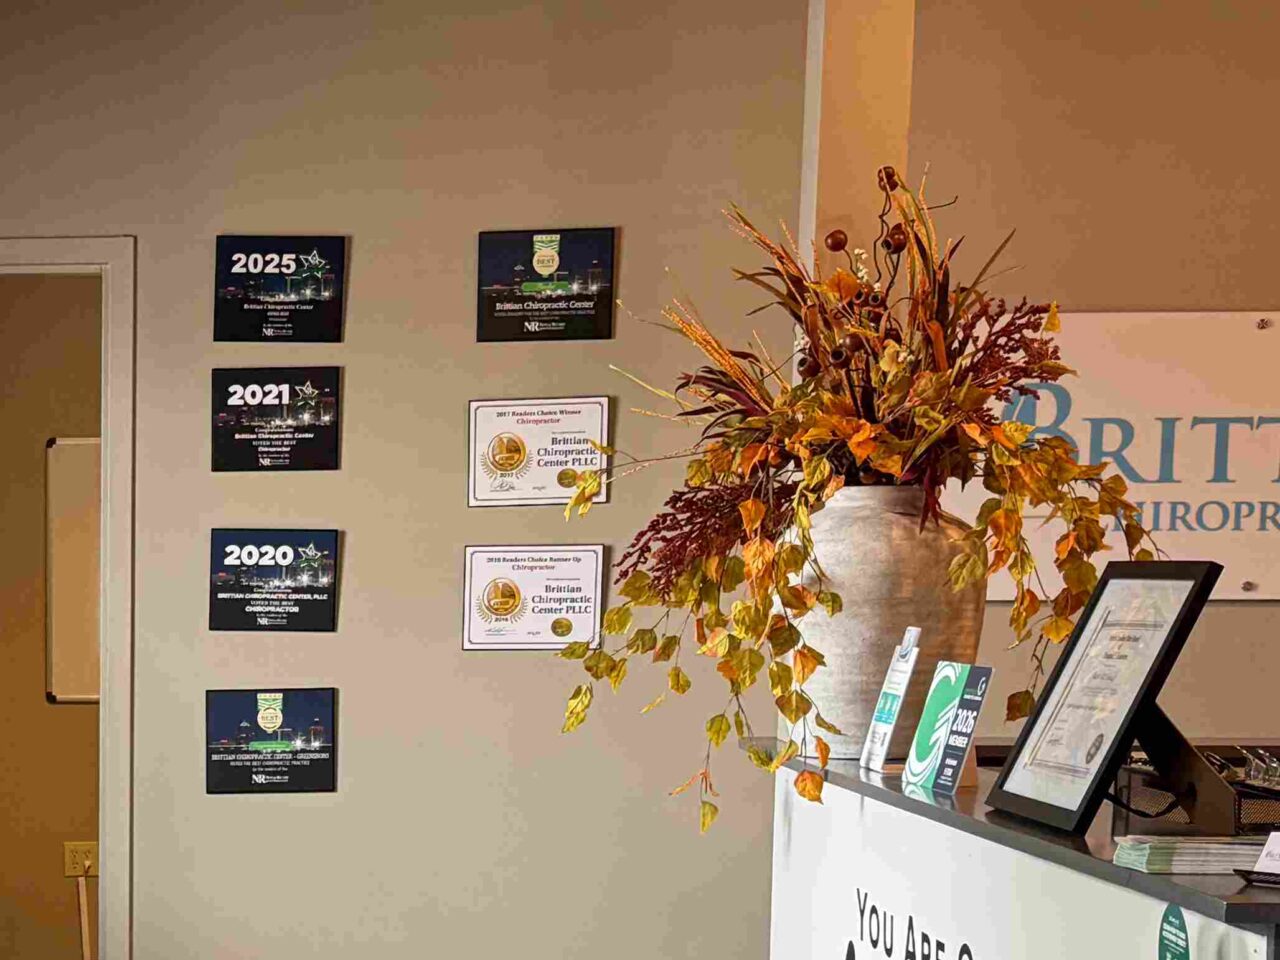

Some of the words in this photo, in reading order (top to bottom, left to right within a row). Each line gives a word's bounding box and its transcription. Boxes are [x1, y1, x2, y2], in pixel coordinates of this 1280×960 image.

[231, 253, 297, 274] 2025
[524, 300, 569, 310] Chiropractic
[570, 300, 595, 308] Center
[227, 384, 290, 406] 2021
[551, 436, 588, 446] Brittian
[537, 447, 599, 458] Chiropractic
[537, 458, 569, 467] Center
[571, 457, 598, 467] PLLC
[223, 545, 294, 566] 2020
[544, 585, 582, 593] Brittian
[531, 595, 592, 605] Chiropractic
[531, 605, 564, 615] Center
[566, 605, 592, 614] PLLC
[951, 708, 978, 734] 2026
[856, 887, 894, 958] YOU
